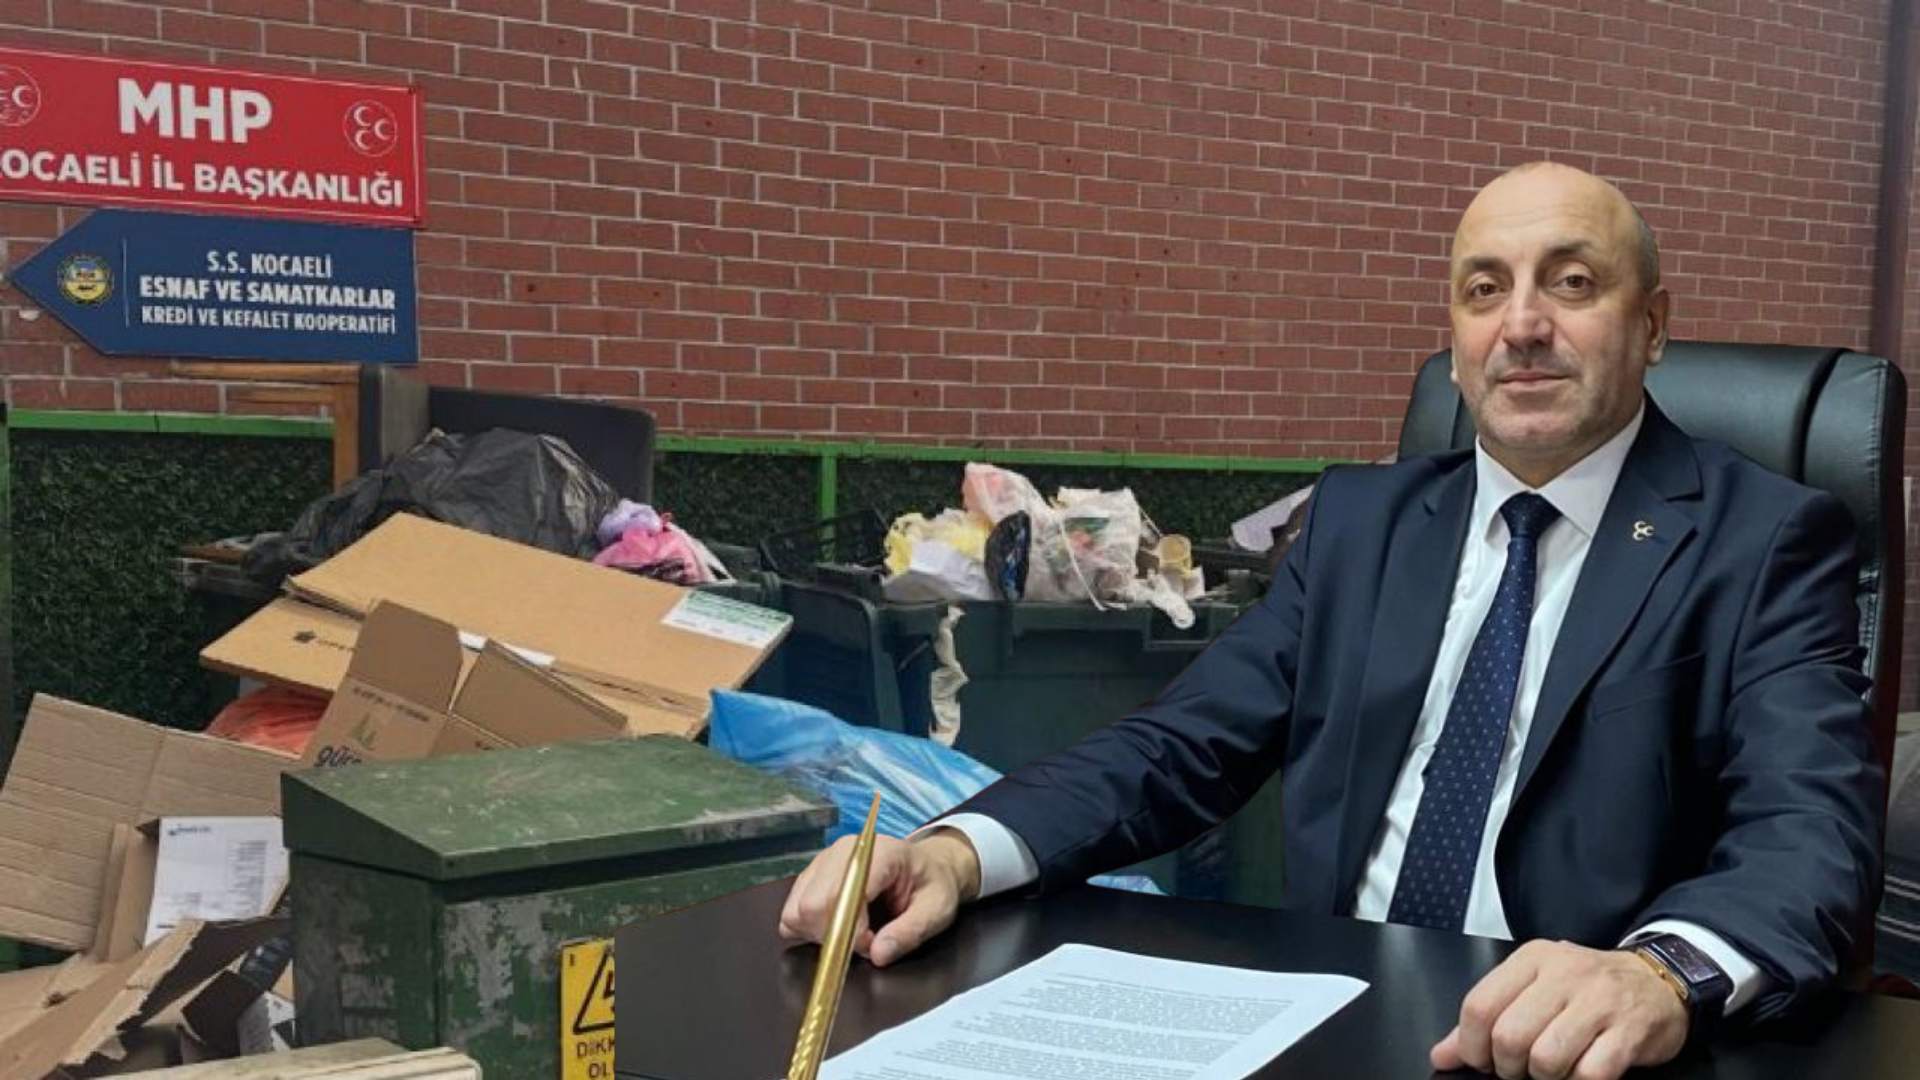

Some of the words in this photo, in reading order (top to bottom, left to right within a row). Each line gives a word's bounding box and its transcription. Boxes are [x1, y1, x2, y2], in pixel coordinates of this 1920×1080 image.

[118, 77, 273, 143] MHP
[0, 149, 141, 188] OCAELİ
[152, 154, 185, 191] İL
[194, 163, 403, 207] BAŞKANLIĞI
[207, 250, 246, 273] S.S.
[251, 253, 332, 279] KOCAELİ
[139, 275, 210, 300] ESNAF
[215, 280, 243, 302] VE
[247, 281, 396, 310] SANATKARLAR
[142, 304, 193, 326] KREDİ
[199, 308, 219, 326] VE
[223, 309, 288, 330] KEFALET
[294, 312, 396, 334] KOOPERATİFİ
